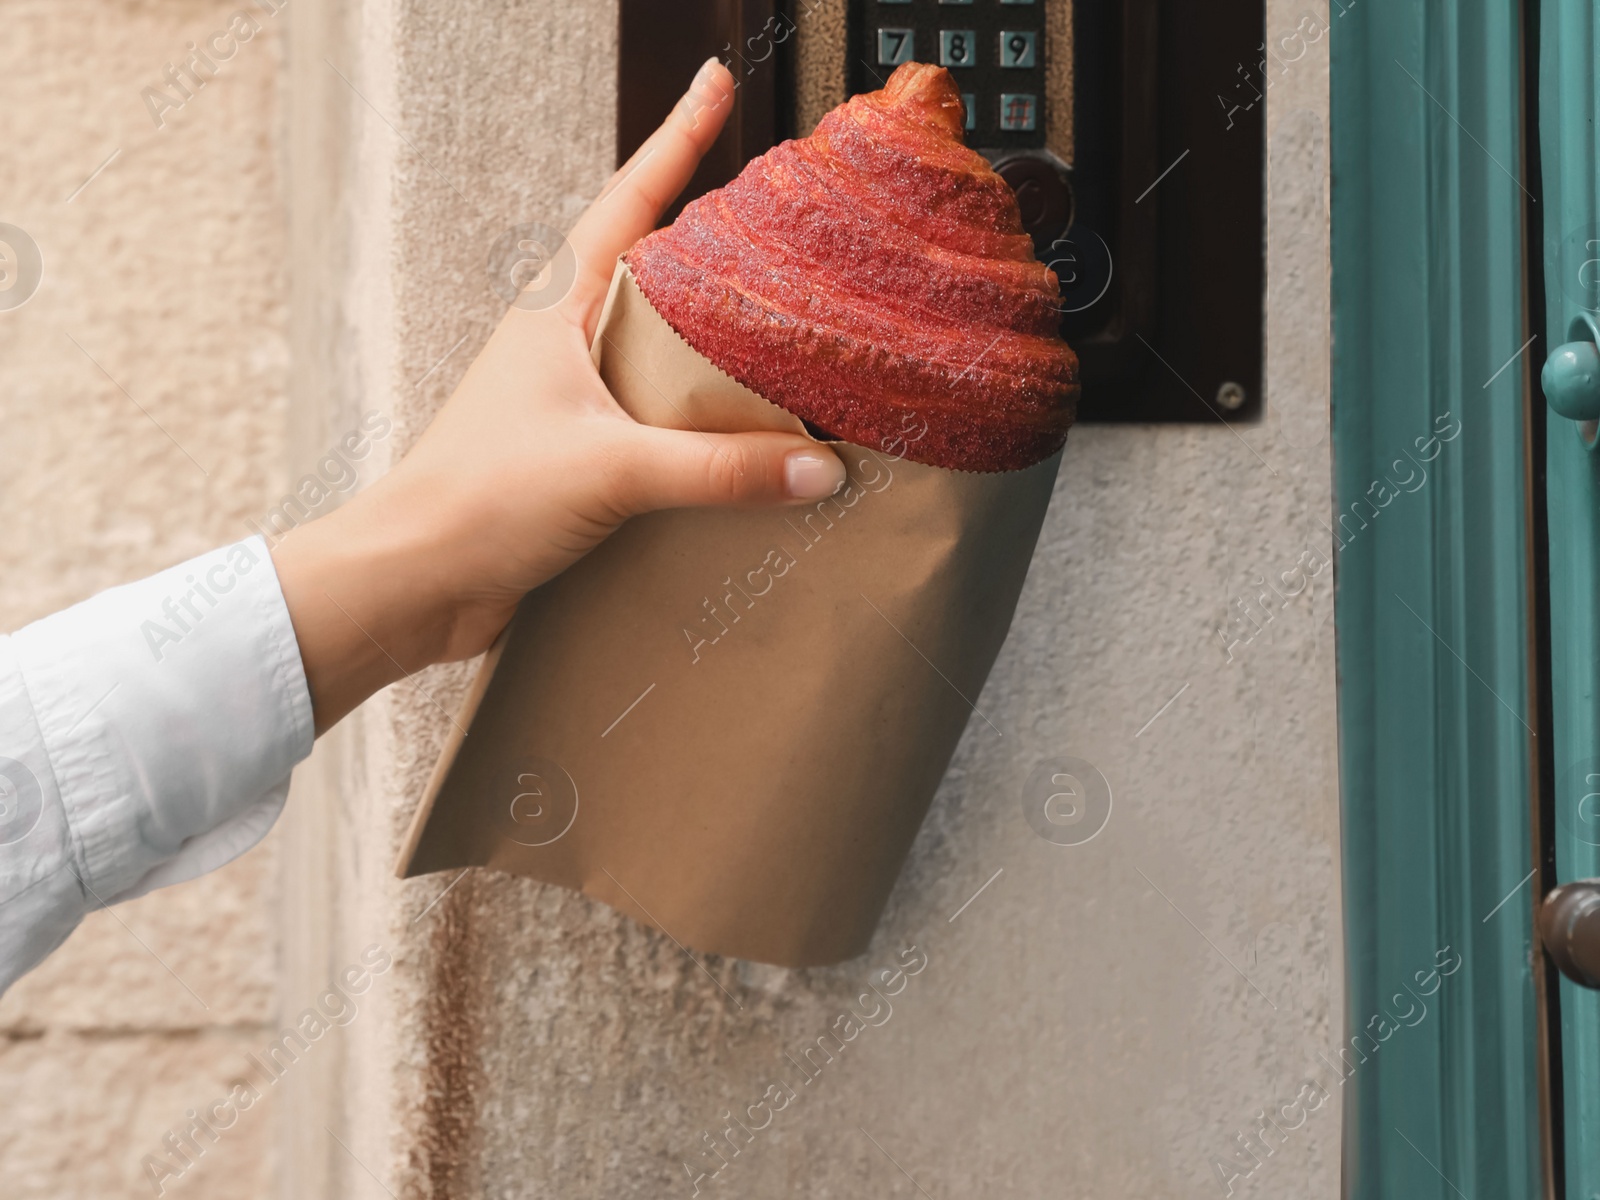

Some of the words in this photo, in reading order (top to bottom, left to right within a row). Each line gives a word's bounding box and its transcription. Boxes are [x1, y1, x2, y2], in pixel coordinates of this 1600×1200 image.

[887, 31, 907, 62] 7
[950, 34, 968, 63] 8
[1010, 35, 1028, 64] 9
